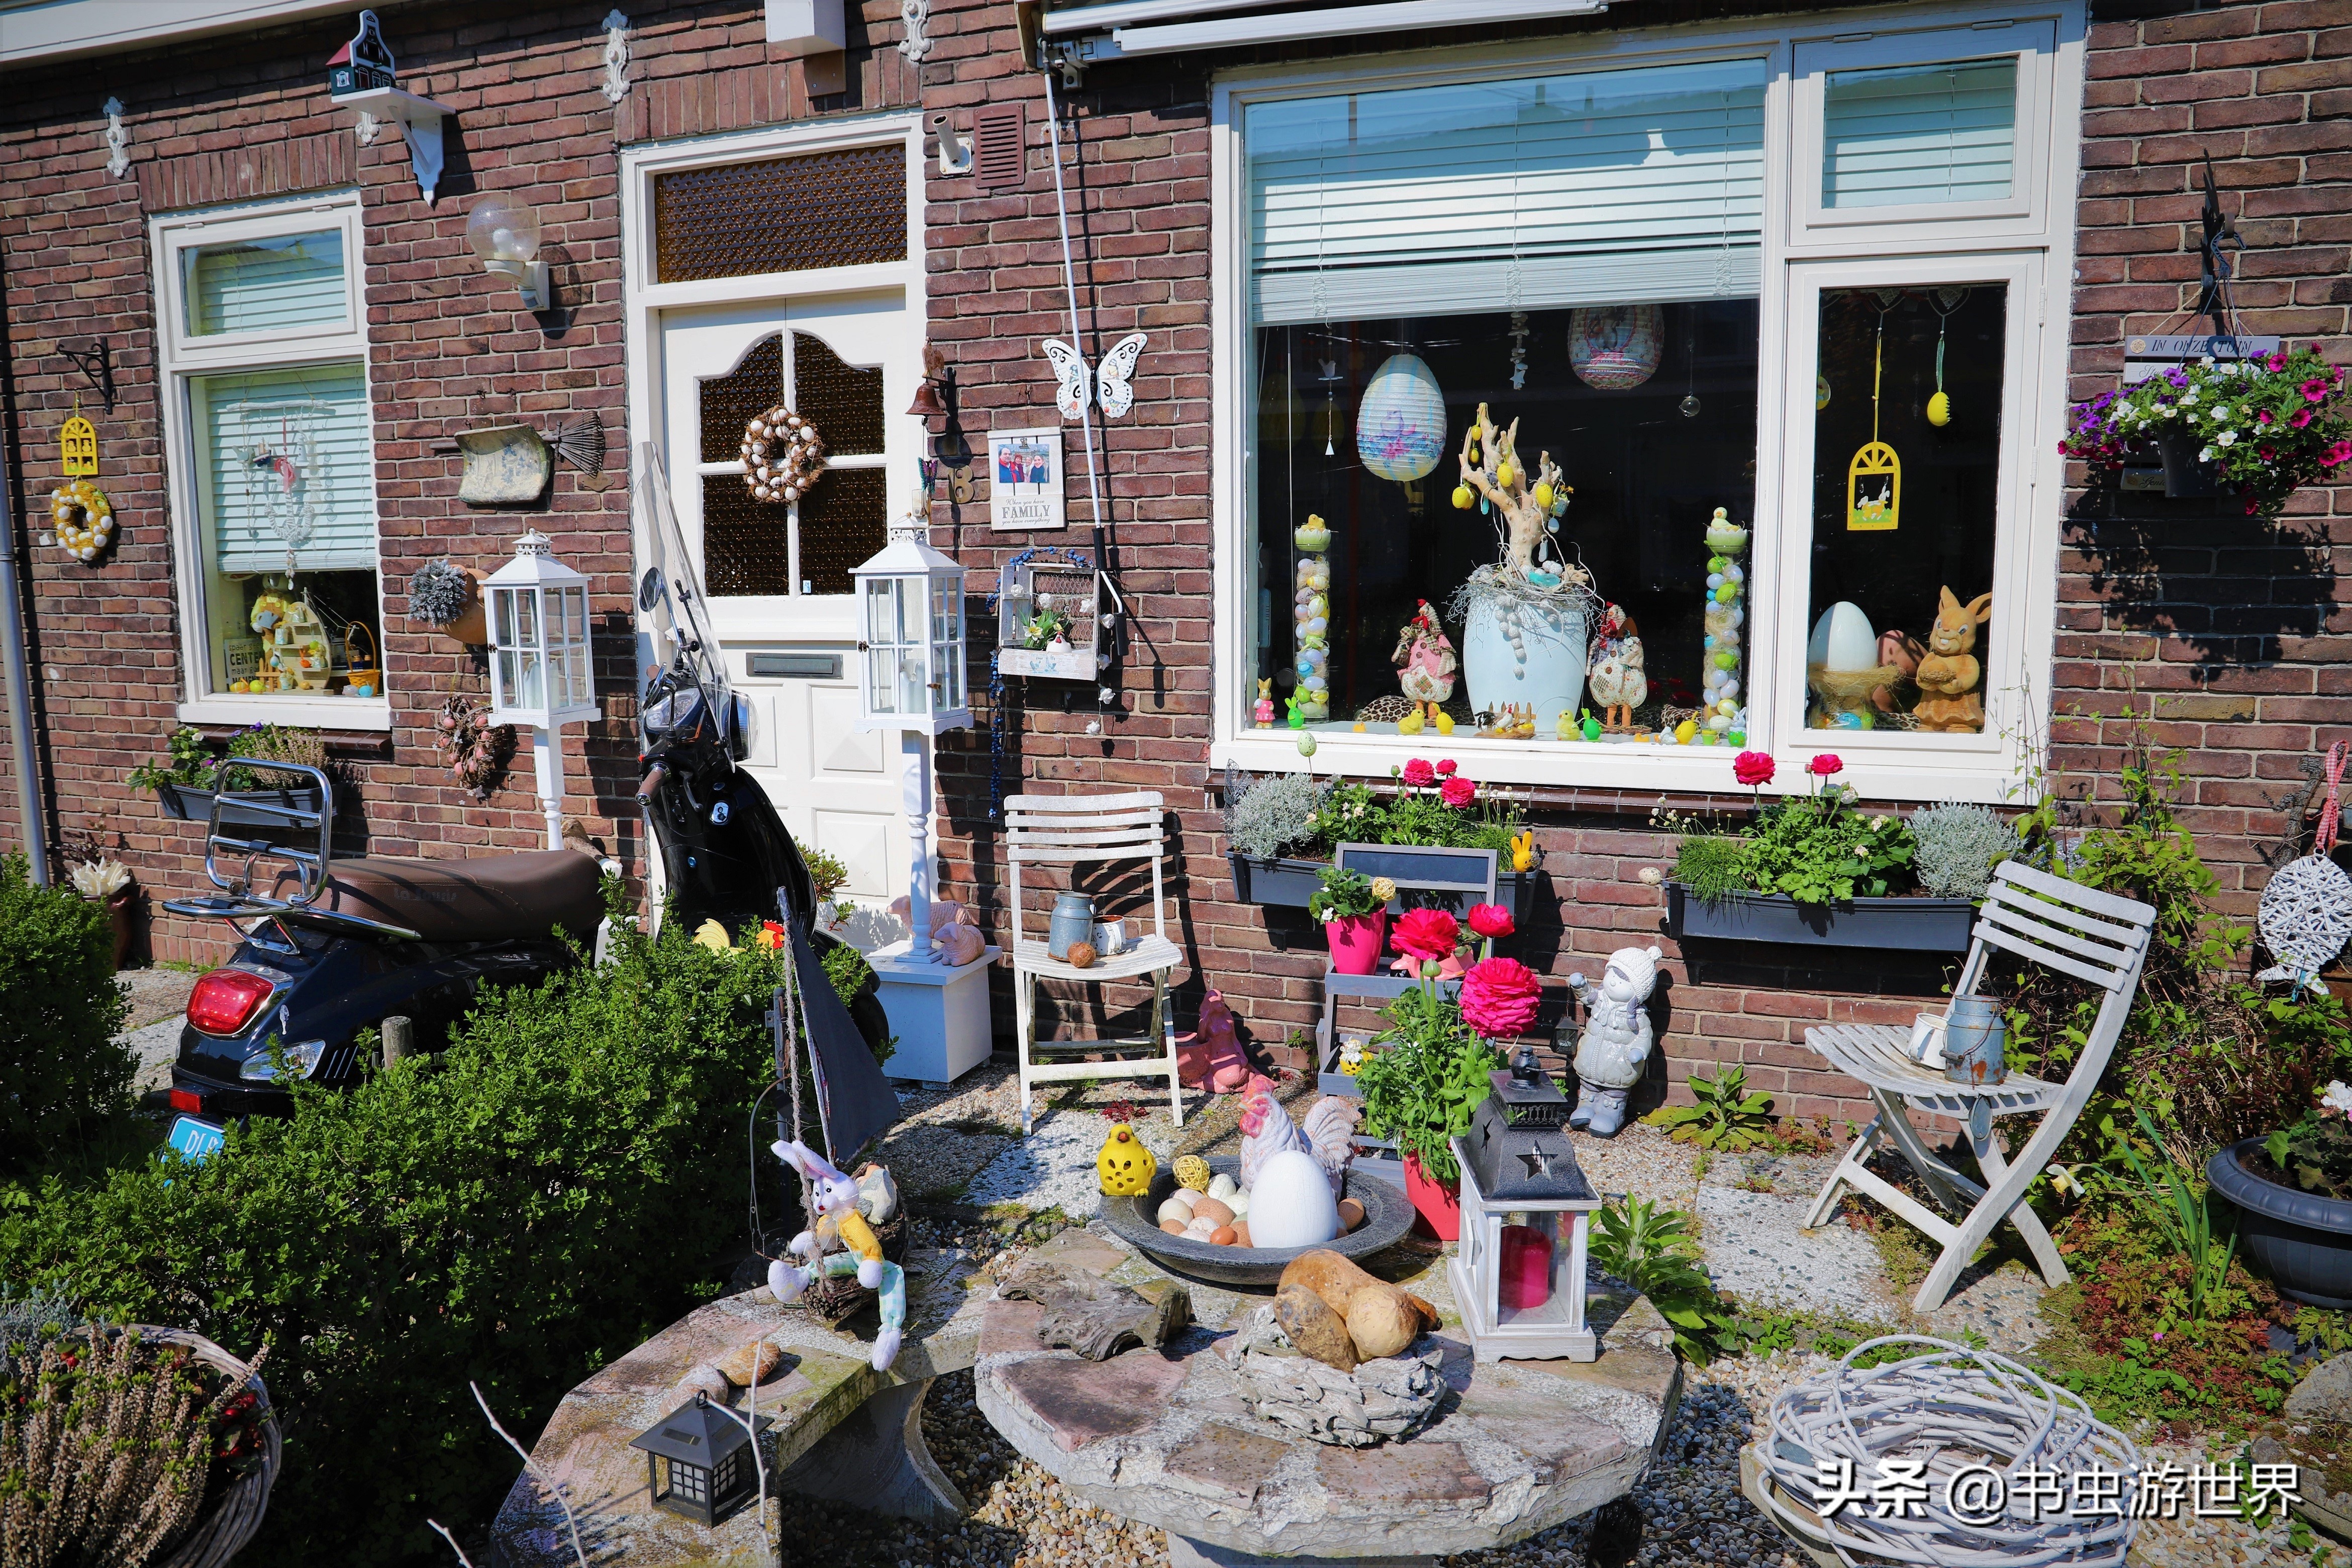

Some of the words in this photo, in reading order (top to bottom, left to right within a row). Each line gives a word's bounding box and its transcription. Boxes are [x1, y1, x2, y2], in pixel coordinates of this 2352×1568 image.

[2151, 340, 2167, 352] IN
[2174, 340, 2209, 352] ONZE
[2218, 340, 2252, 353] TUIN
[1002, 505, 1050, 519] FAMILY
[1024, 517, 1050, 525] everything
